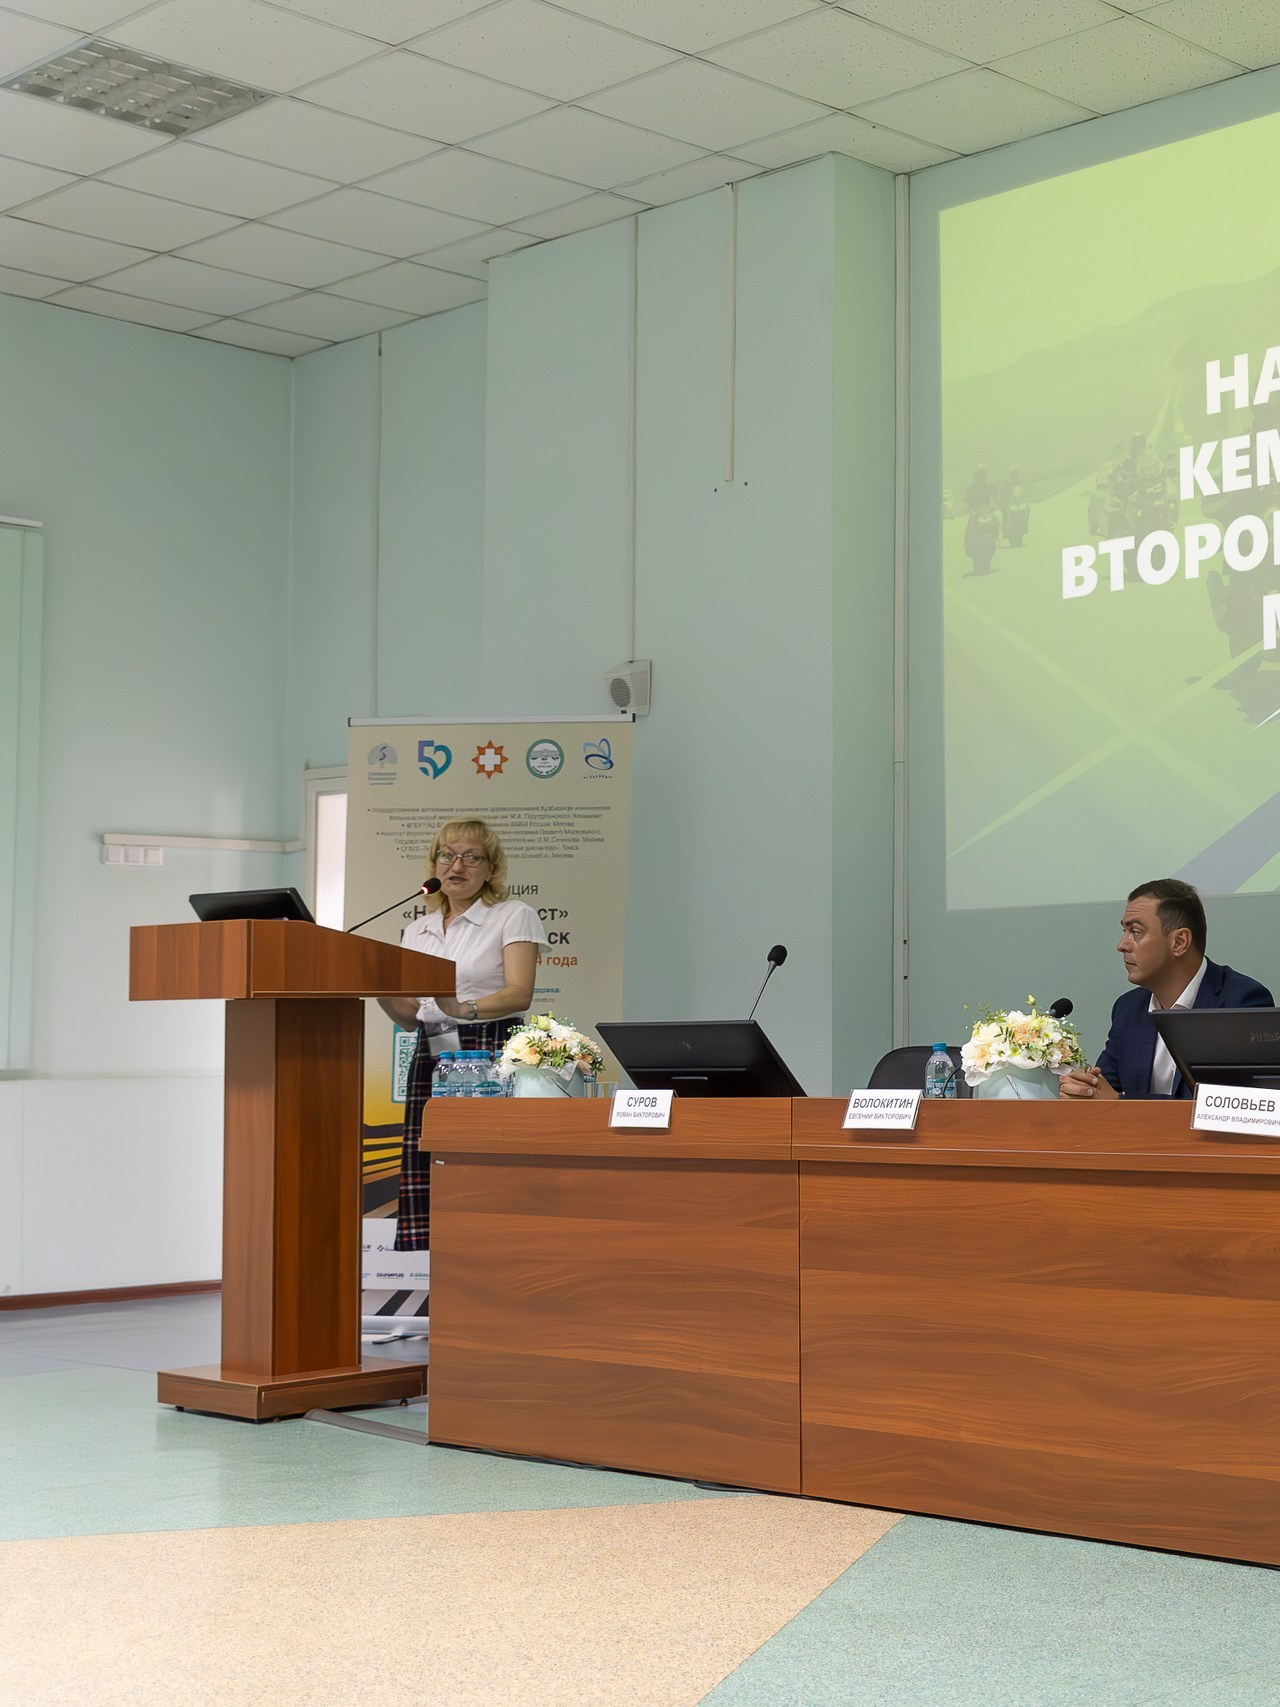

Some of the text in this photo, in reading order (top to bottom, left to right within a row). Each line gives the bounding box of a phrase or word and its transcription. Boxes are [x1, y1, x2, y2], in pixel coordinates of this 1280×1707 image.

[537, 907, 569, 921] СТ»
[546, 956, 578, 968] года
[627, 1096, 658, 1108] СУРОВ
[852, 1098, 914, 1109] ВОЛОКИТИН
[1205, 1095, 1276, 1112] СОЛОВЬЕВ
[616, 1111, 632, 1119] РОМАН
[873, 1112, 912, 1120] ВИКТОРОВИЧ
[1196, 1113, 1280, 1126] АЛЕКСАНДР ВЛАДИМИРОВИЧ
